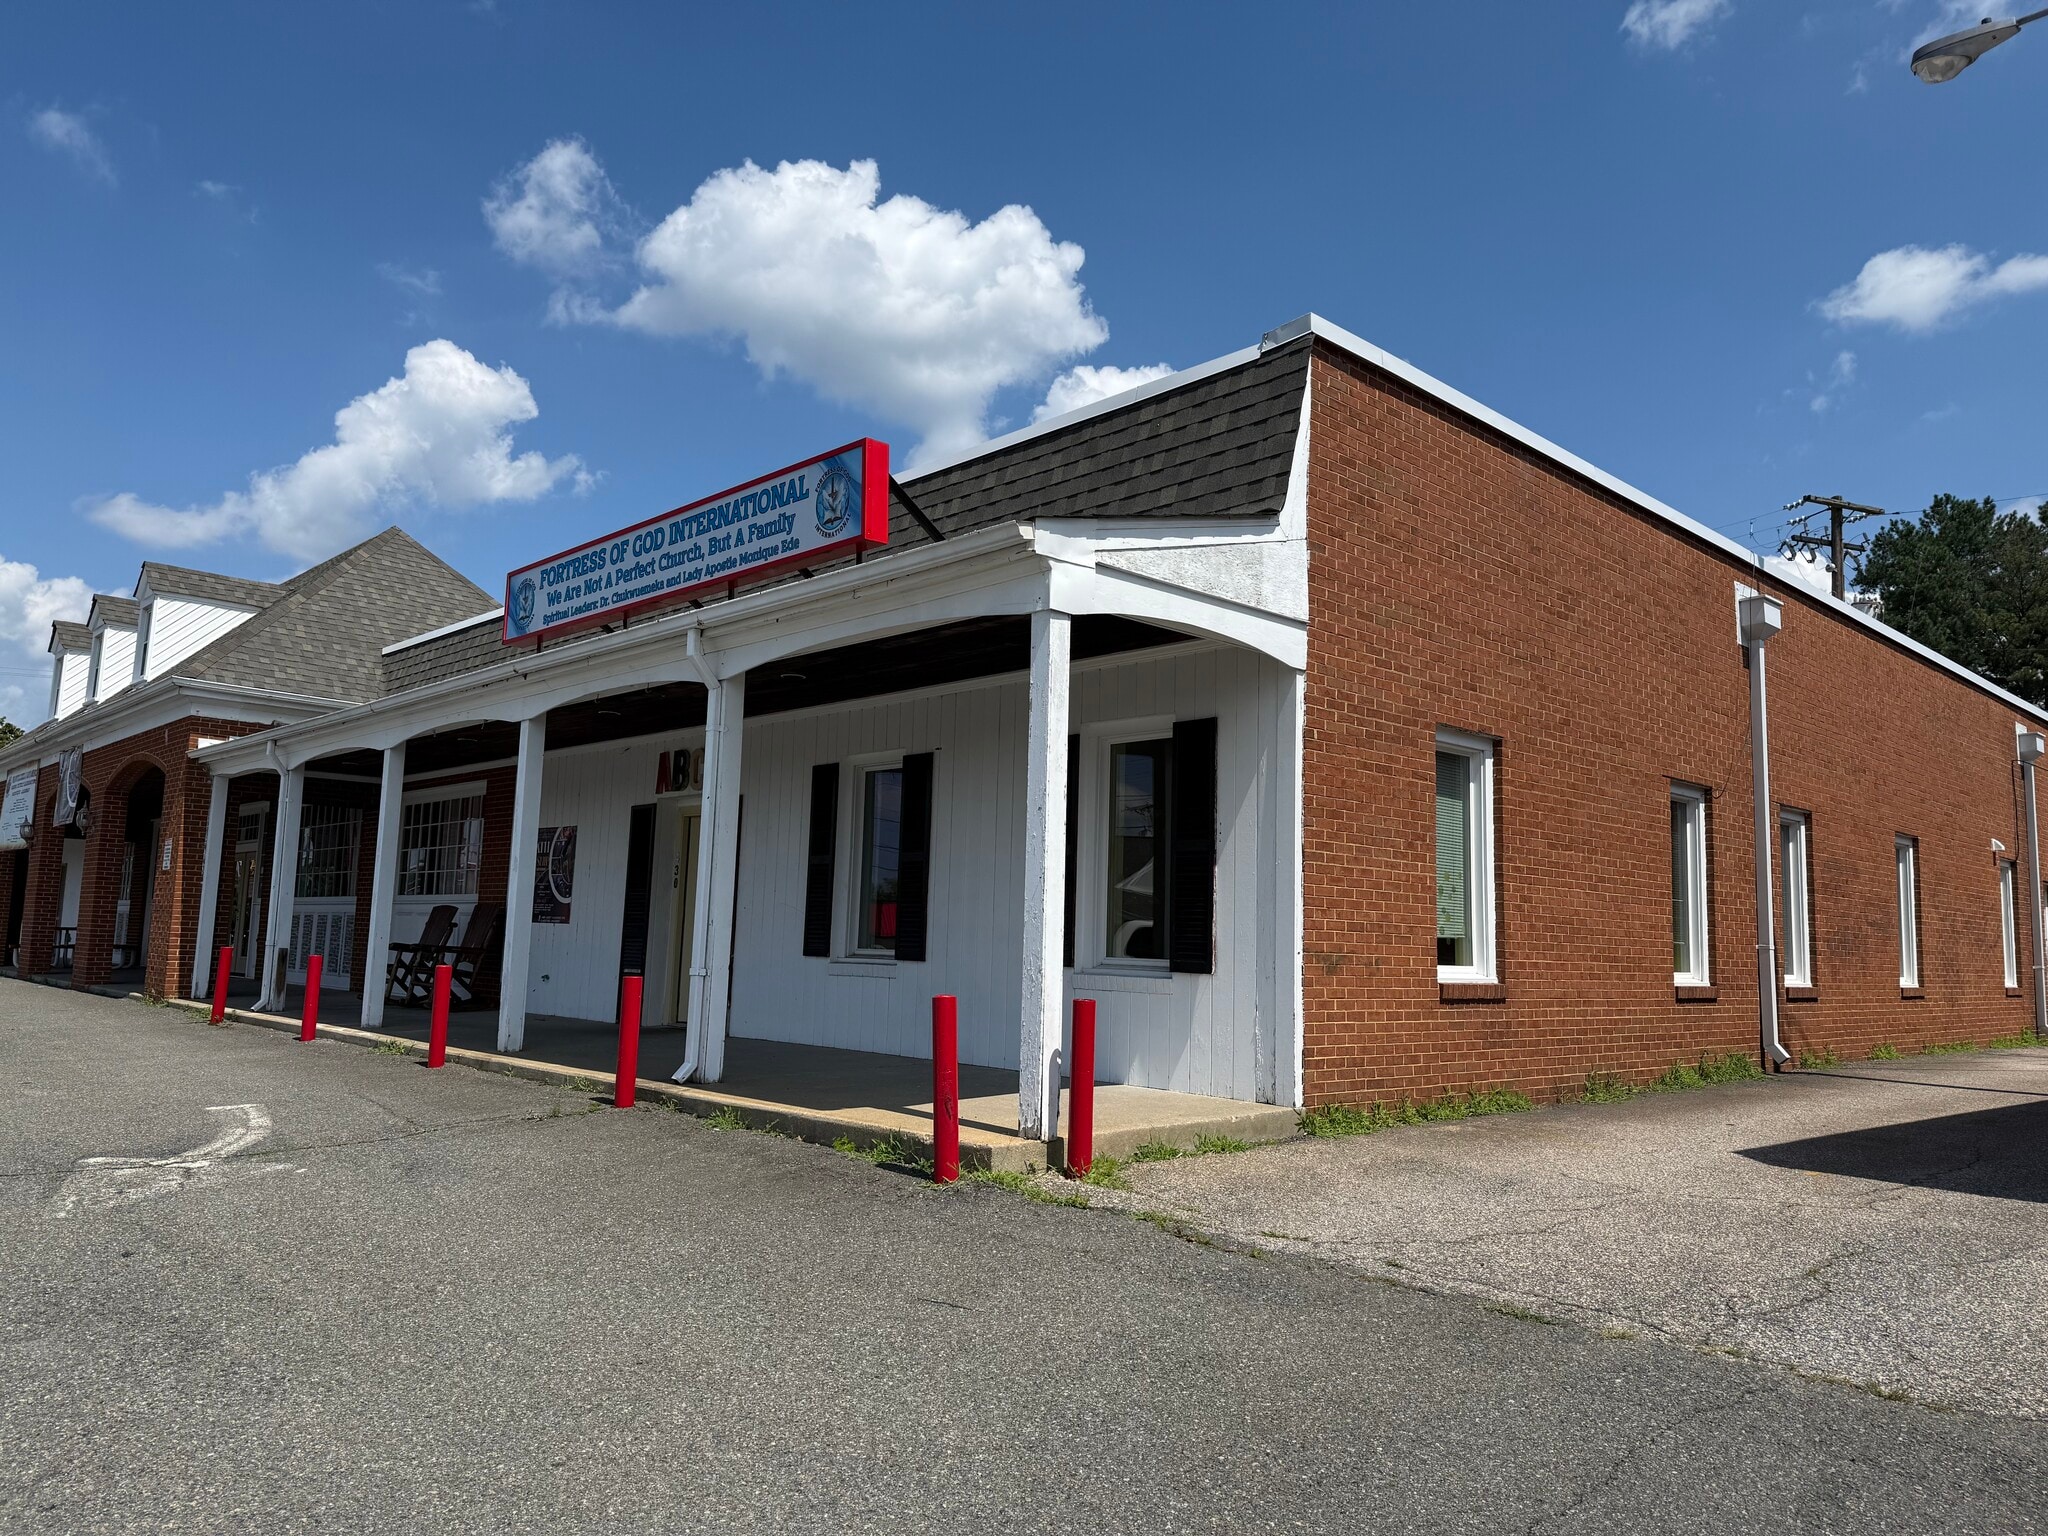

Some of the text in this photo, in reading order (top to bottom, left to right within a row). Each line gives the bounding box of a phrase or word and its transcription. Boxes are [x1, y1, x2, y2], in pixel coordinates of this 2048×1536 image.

[539, 474, 809, 590] FORTRESS OF GOD INTERNATIONAL
[547, 512, 796, 607] We Are Not A Perfect Church, But A Family
[543, 537, 799, 626] Spiritual Leaders: Dr. Chukwuemeka and Lady Apostle Monique Ede
